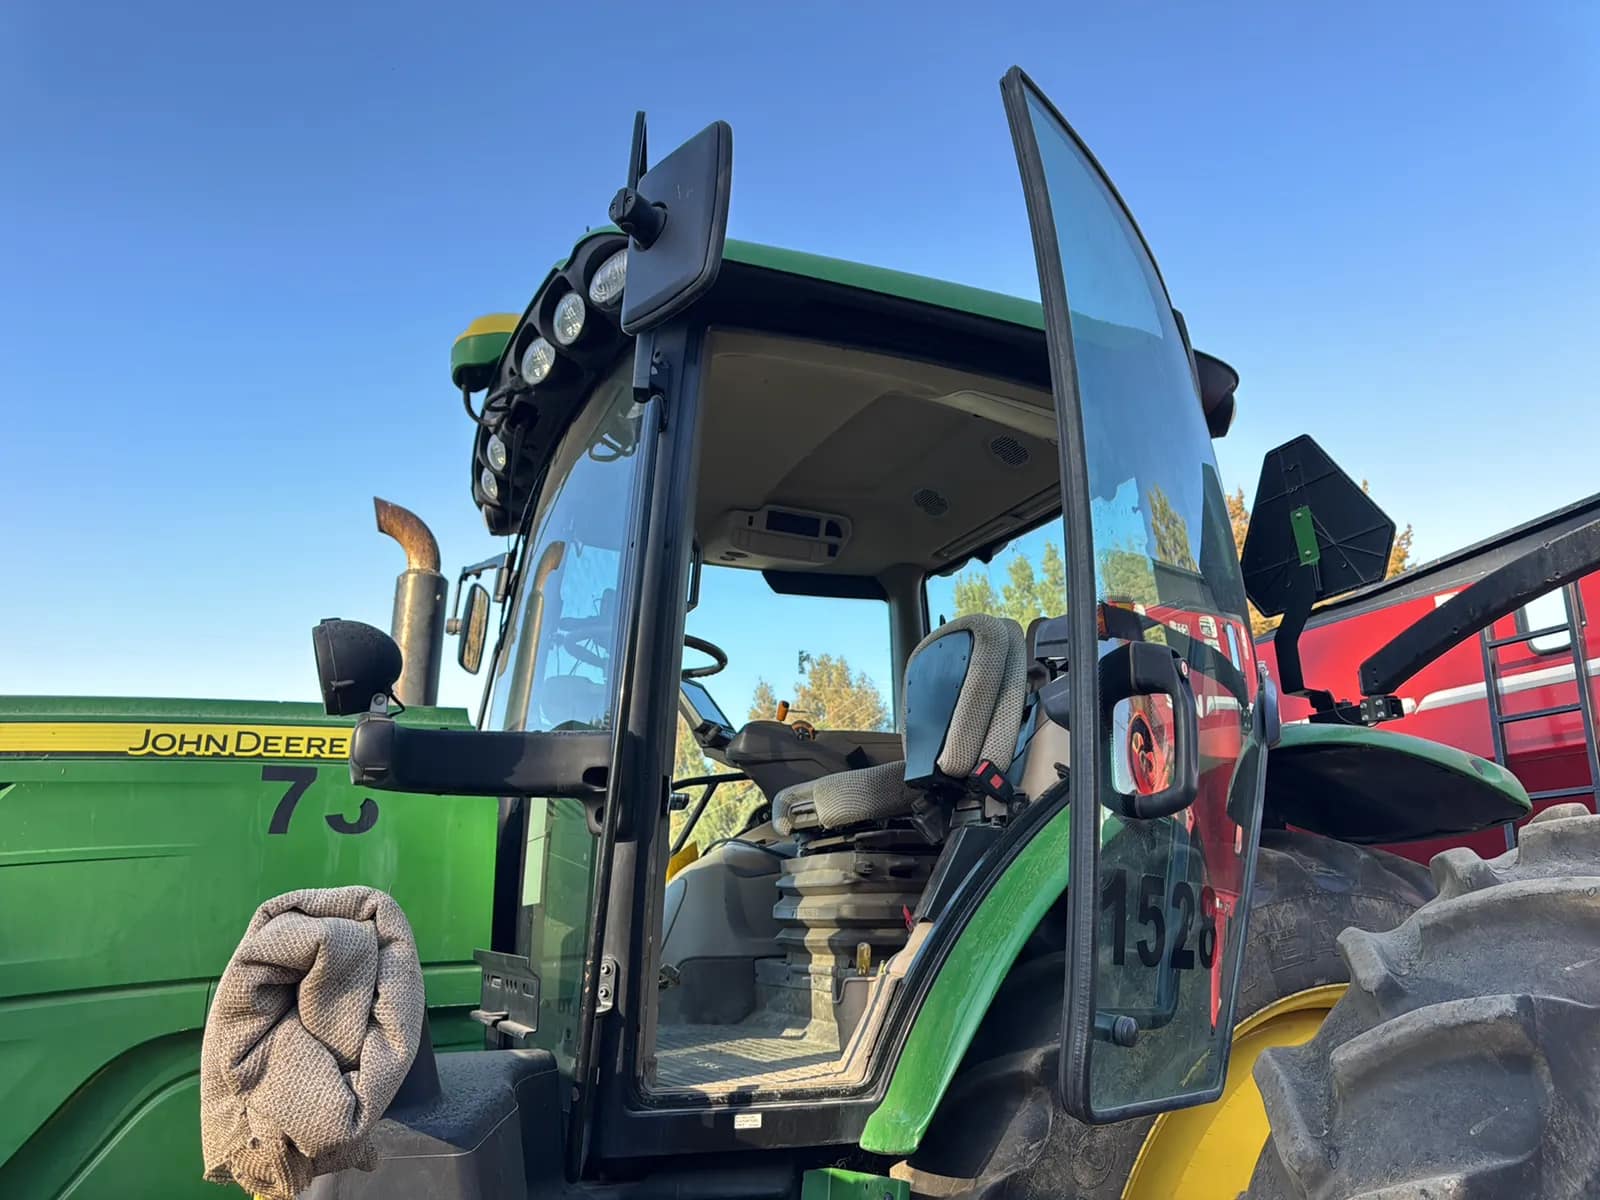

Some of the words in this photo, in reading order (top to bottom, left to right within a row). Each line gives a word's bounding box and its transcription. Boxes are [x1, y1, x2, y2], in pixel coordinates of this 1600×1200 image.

[128, 729, 229, 753] JOHN
[236, 731, 347, 755] DEERE
[1102, 868, 1218, 970] 1528
